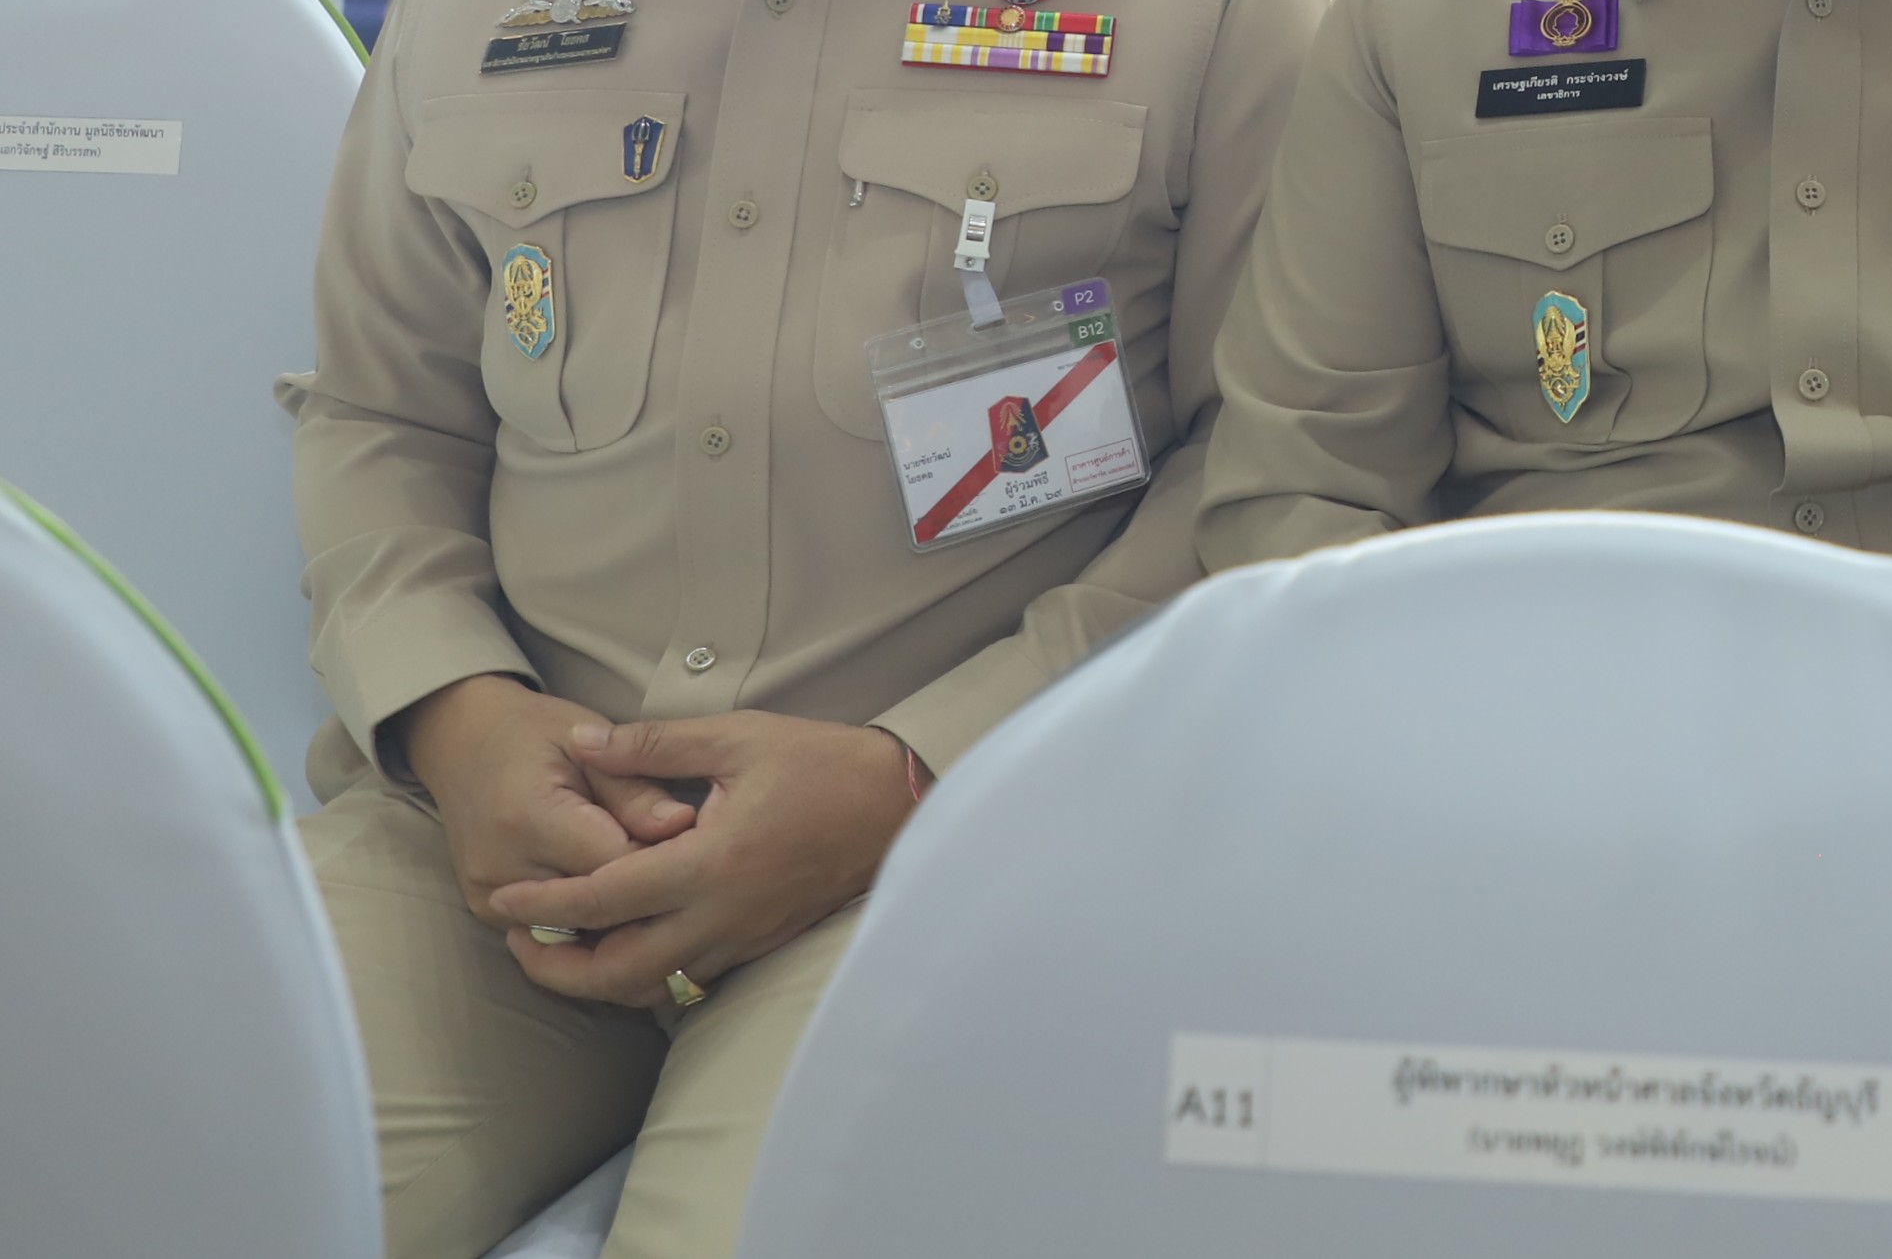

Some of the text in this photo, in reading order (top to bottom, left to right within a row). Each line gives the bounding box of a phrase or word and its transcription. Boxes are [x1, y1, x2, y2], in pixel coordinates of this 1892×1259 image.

[1492, 69, 1629, 92] เศรษฐเกียรติ กระจ่างวงษ์
[1537, 89, 1580, 100] เลขาธิการ
[85, 123, 164, 140] มูลนิธิชัยพัฒนา
[1074, 290, 1094, 305] P2
[1078, 321, 1105, 340] B12
[1004, 472, 1050, 499] ผู้ร่วมพิธี
[1019, 493, 1042, 510] มี.ค.
[1174, 1082, 1254, 1130] A11
